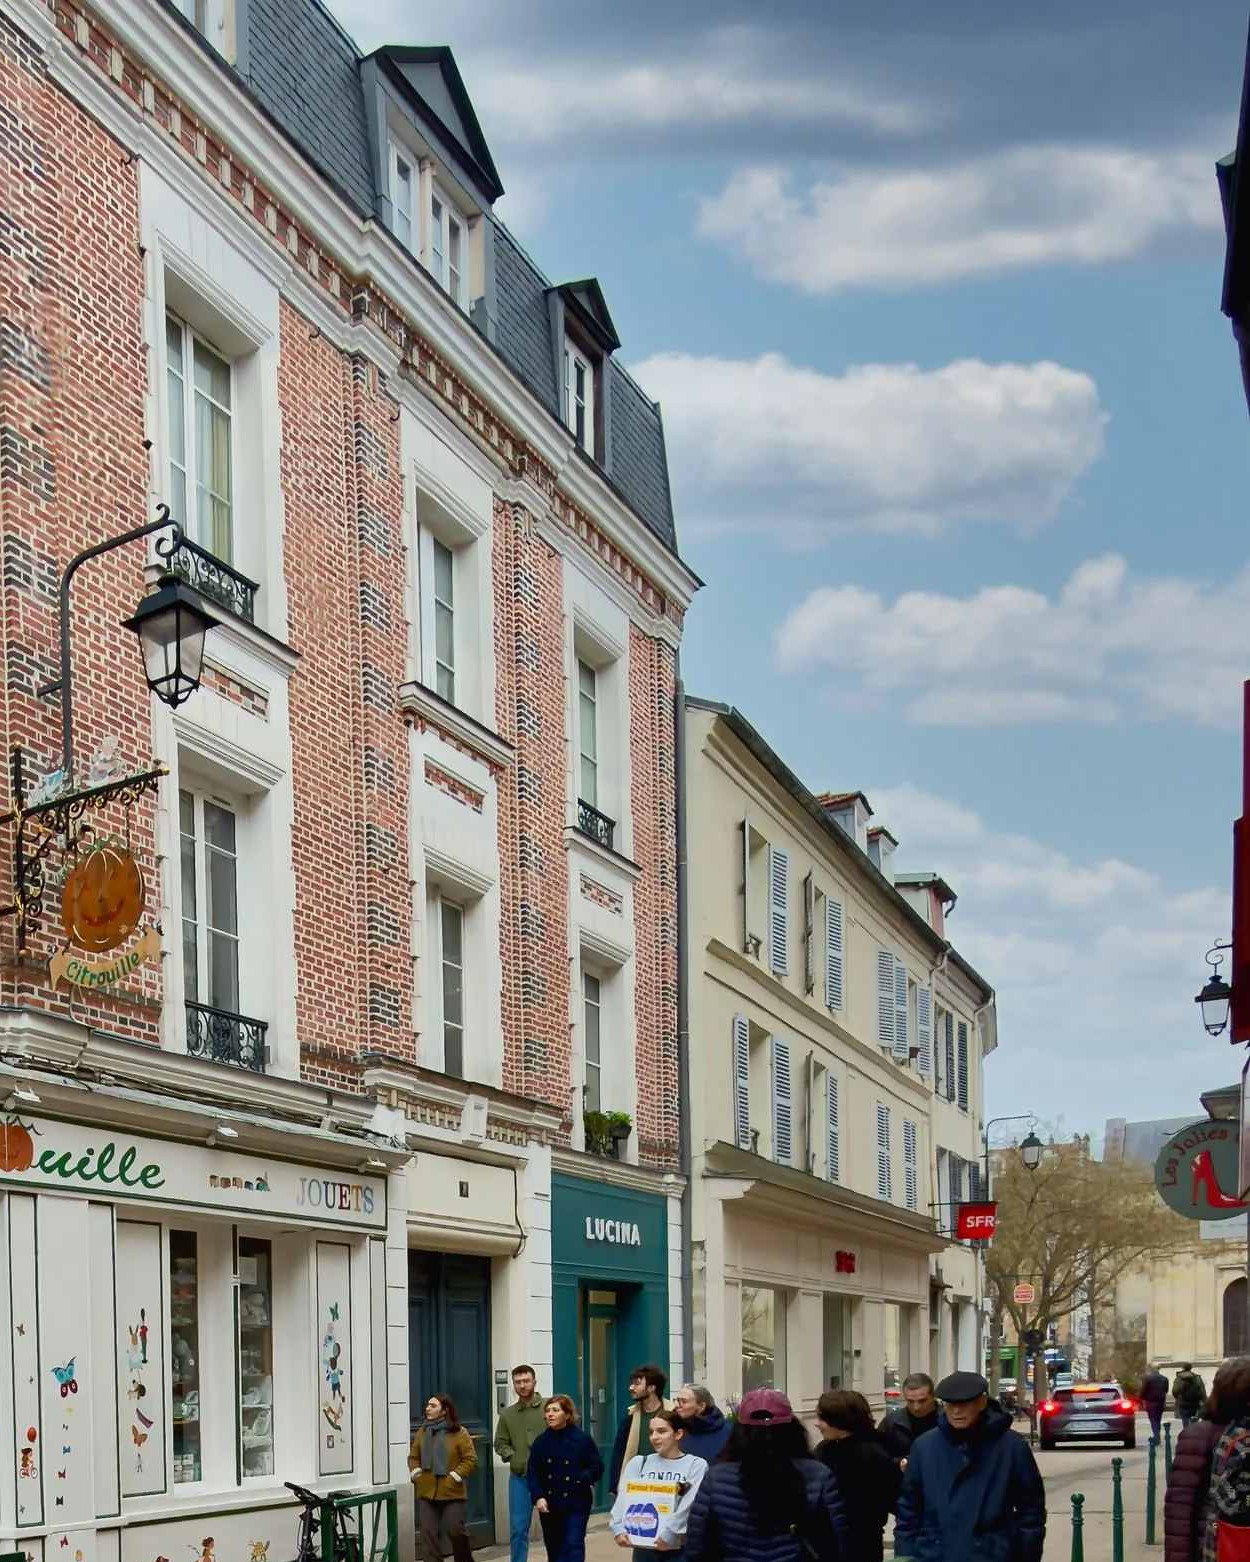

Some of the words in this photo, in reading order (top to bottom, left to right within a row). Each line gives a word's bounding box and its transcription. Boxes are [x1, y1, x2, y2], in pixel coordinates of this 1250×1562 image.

[66, 952, 139, 986] Citrouille
[1172, 1129, 1228, 1156] Jolies
[296, 1177, 374, 1214] JOUETS
[585, 1216, 641, 1246] LUCINA
[966, 1215, 995, 1228] SFR
